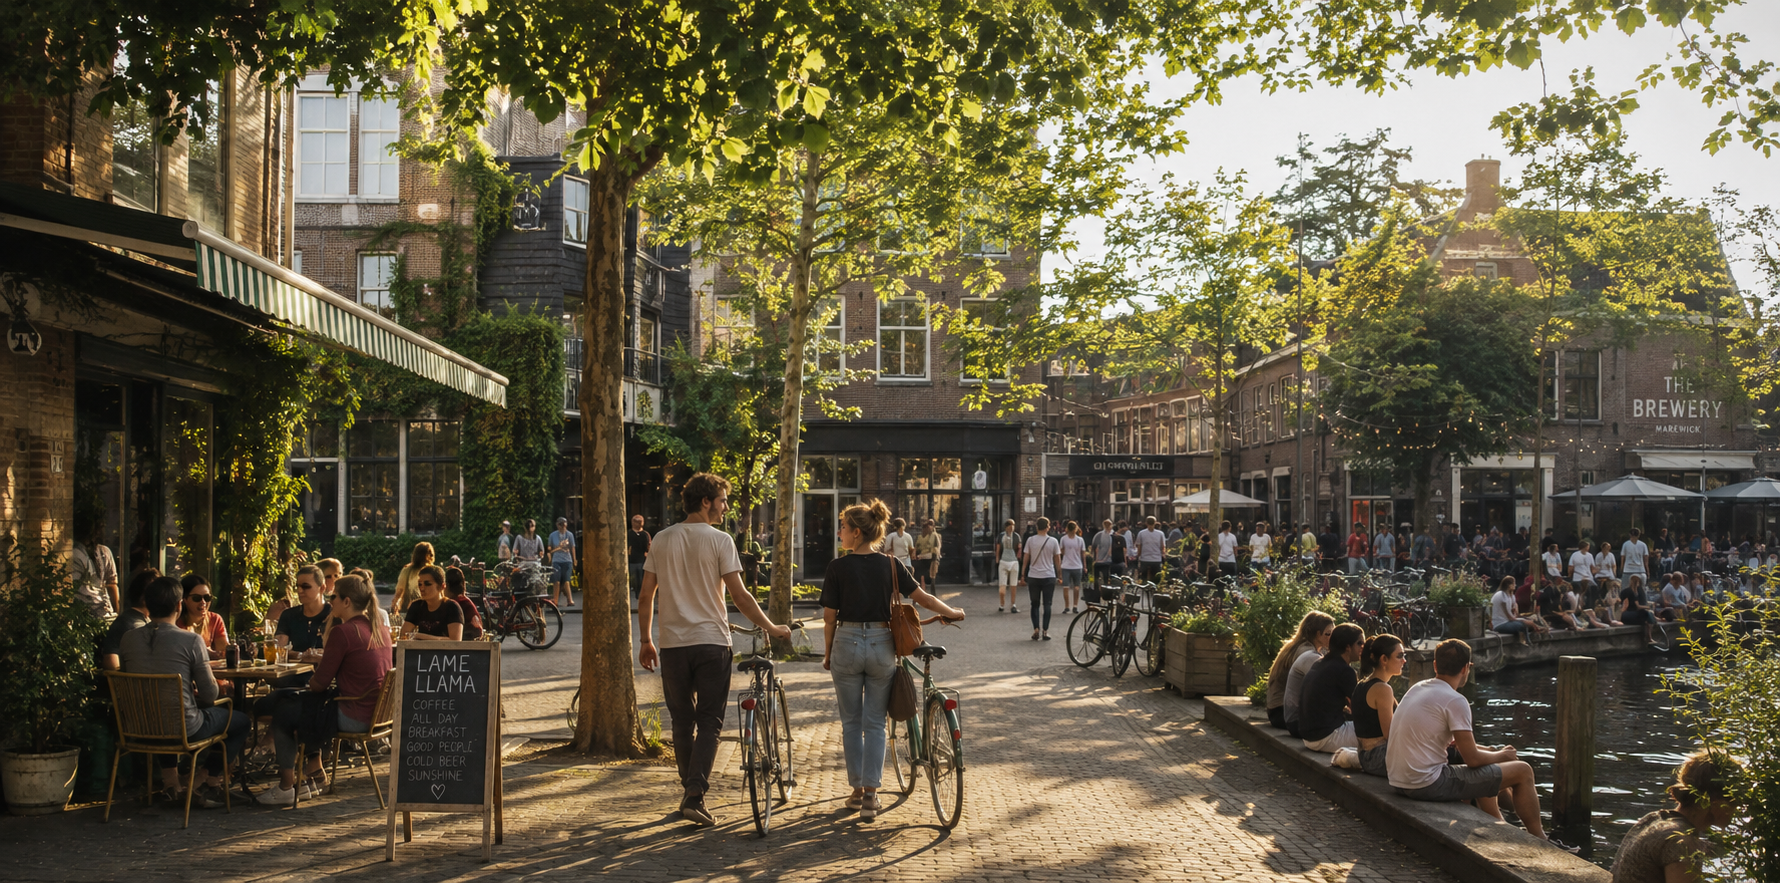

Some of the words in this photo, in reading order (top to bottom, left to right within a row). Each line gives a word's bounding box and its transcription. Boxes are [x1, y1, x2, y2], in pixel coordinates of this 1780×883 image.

[1663, 376, 1695, 393] THE
[1633, 399, 1722, 419] BREWERY
[417, 654, 470, 672] LAME
[415, 674, 476, 693] LLAMA
[412, 699, 456, 711] COFFEE
[411, 713, 432, 724] ALL
[438, 713, 458, 724] DAY
[408, 726, 467, 738] BREAKFAST
[406, 741, 434, 753] GOOD
[406, 755, 434, 767] COLD
[439, 755, 467, 767] BEER
[407, 769, 463, 781] SUNSHINE
